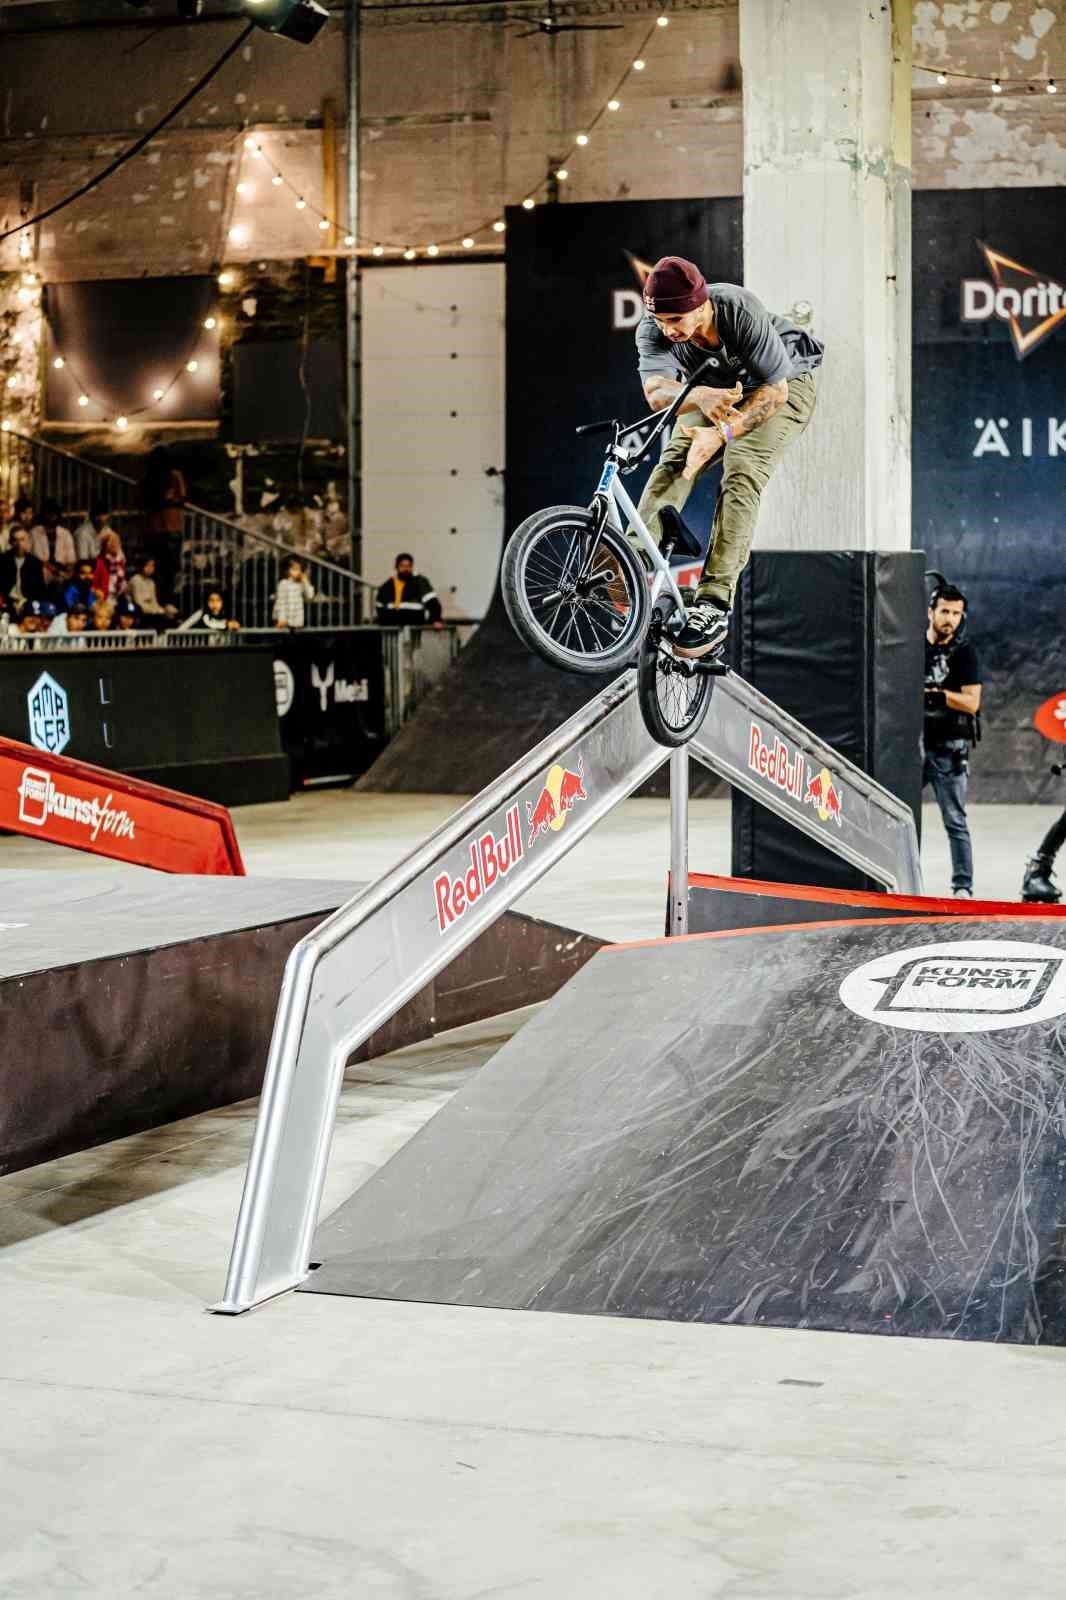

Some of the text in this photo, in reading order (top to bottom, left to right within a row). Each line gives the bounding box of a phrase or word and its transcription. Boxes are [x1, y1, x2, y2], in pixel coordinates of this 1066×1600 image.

[963, 280, 1066, 320] Dorit
[918, 966, 1037, 977] KUNST
[911, 976, 1032, 990] FORM
